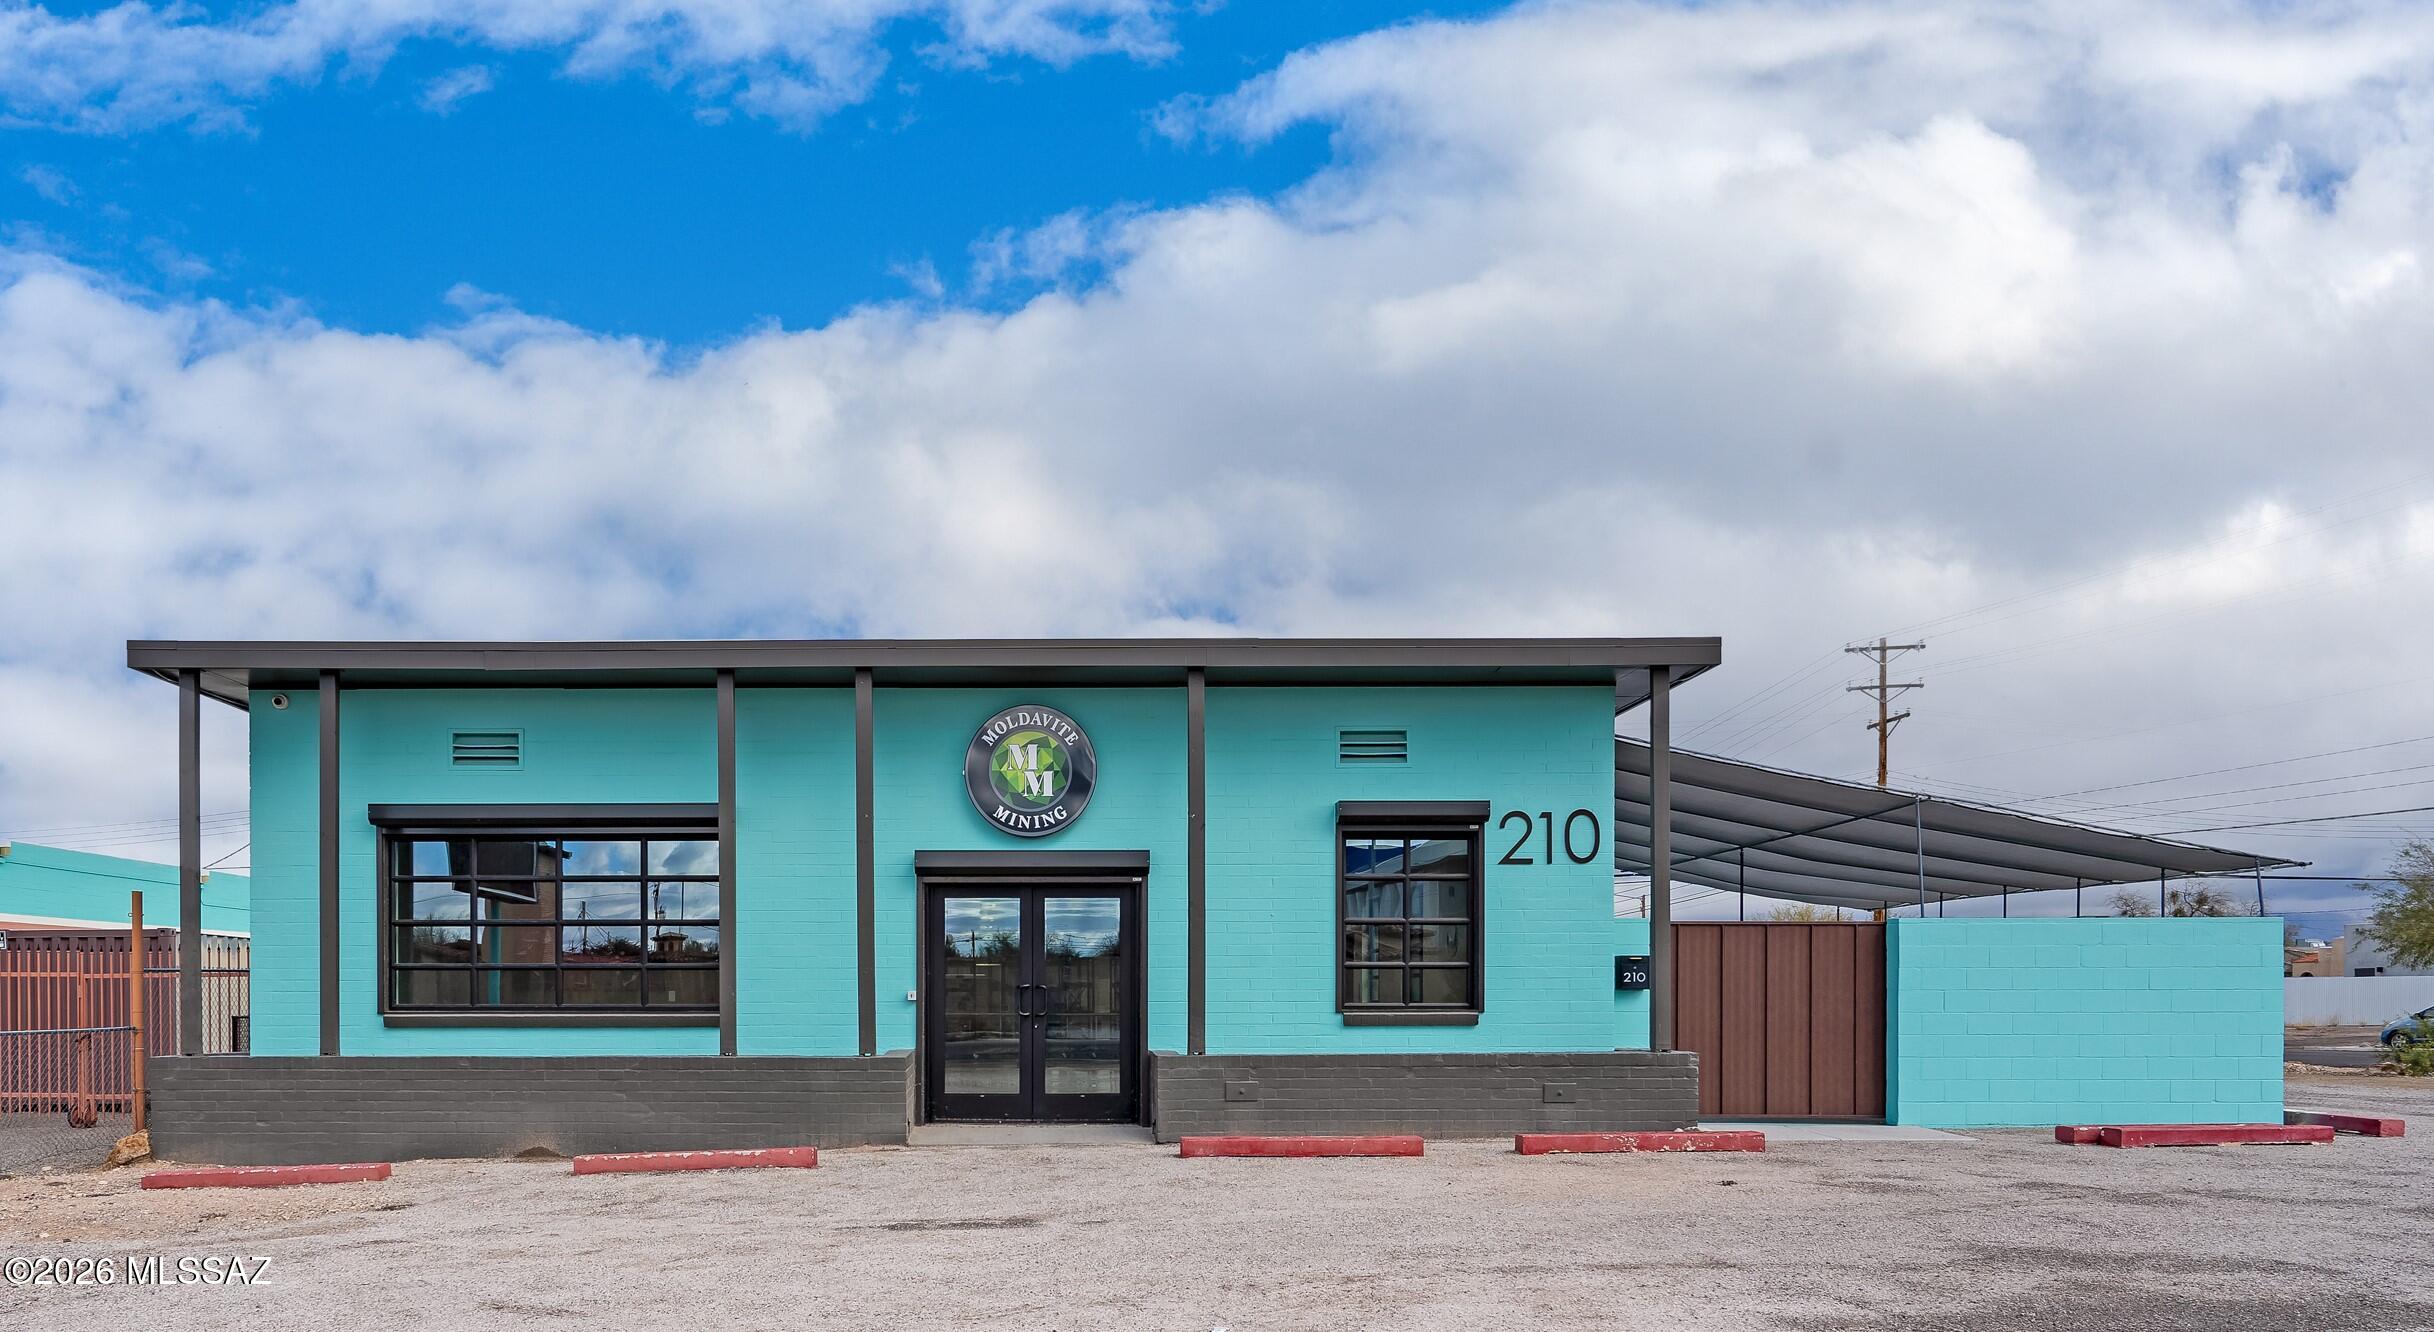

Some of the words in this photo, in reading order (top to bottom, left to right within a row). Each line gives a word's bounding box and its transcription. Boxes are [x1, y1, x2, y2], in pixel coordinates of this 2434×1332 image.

[981, 711, 1080, 747] MOLDAVITE
[1007, 743, 1038, 770] M
[1023, 770, 1054, 797] M
[993, 805, 1067, 829] MINING
[1497, 808, 1600, 865] 210
[1623, 972, 1646, 983] 210
